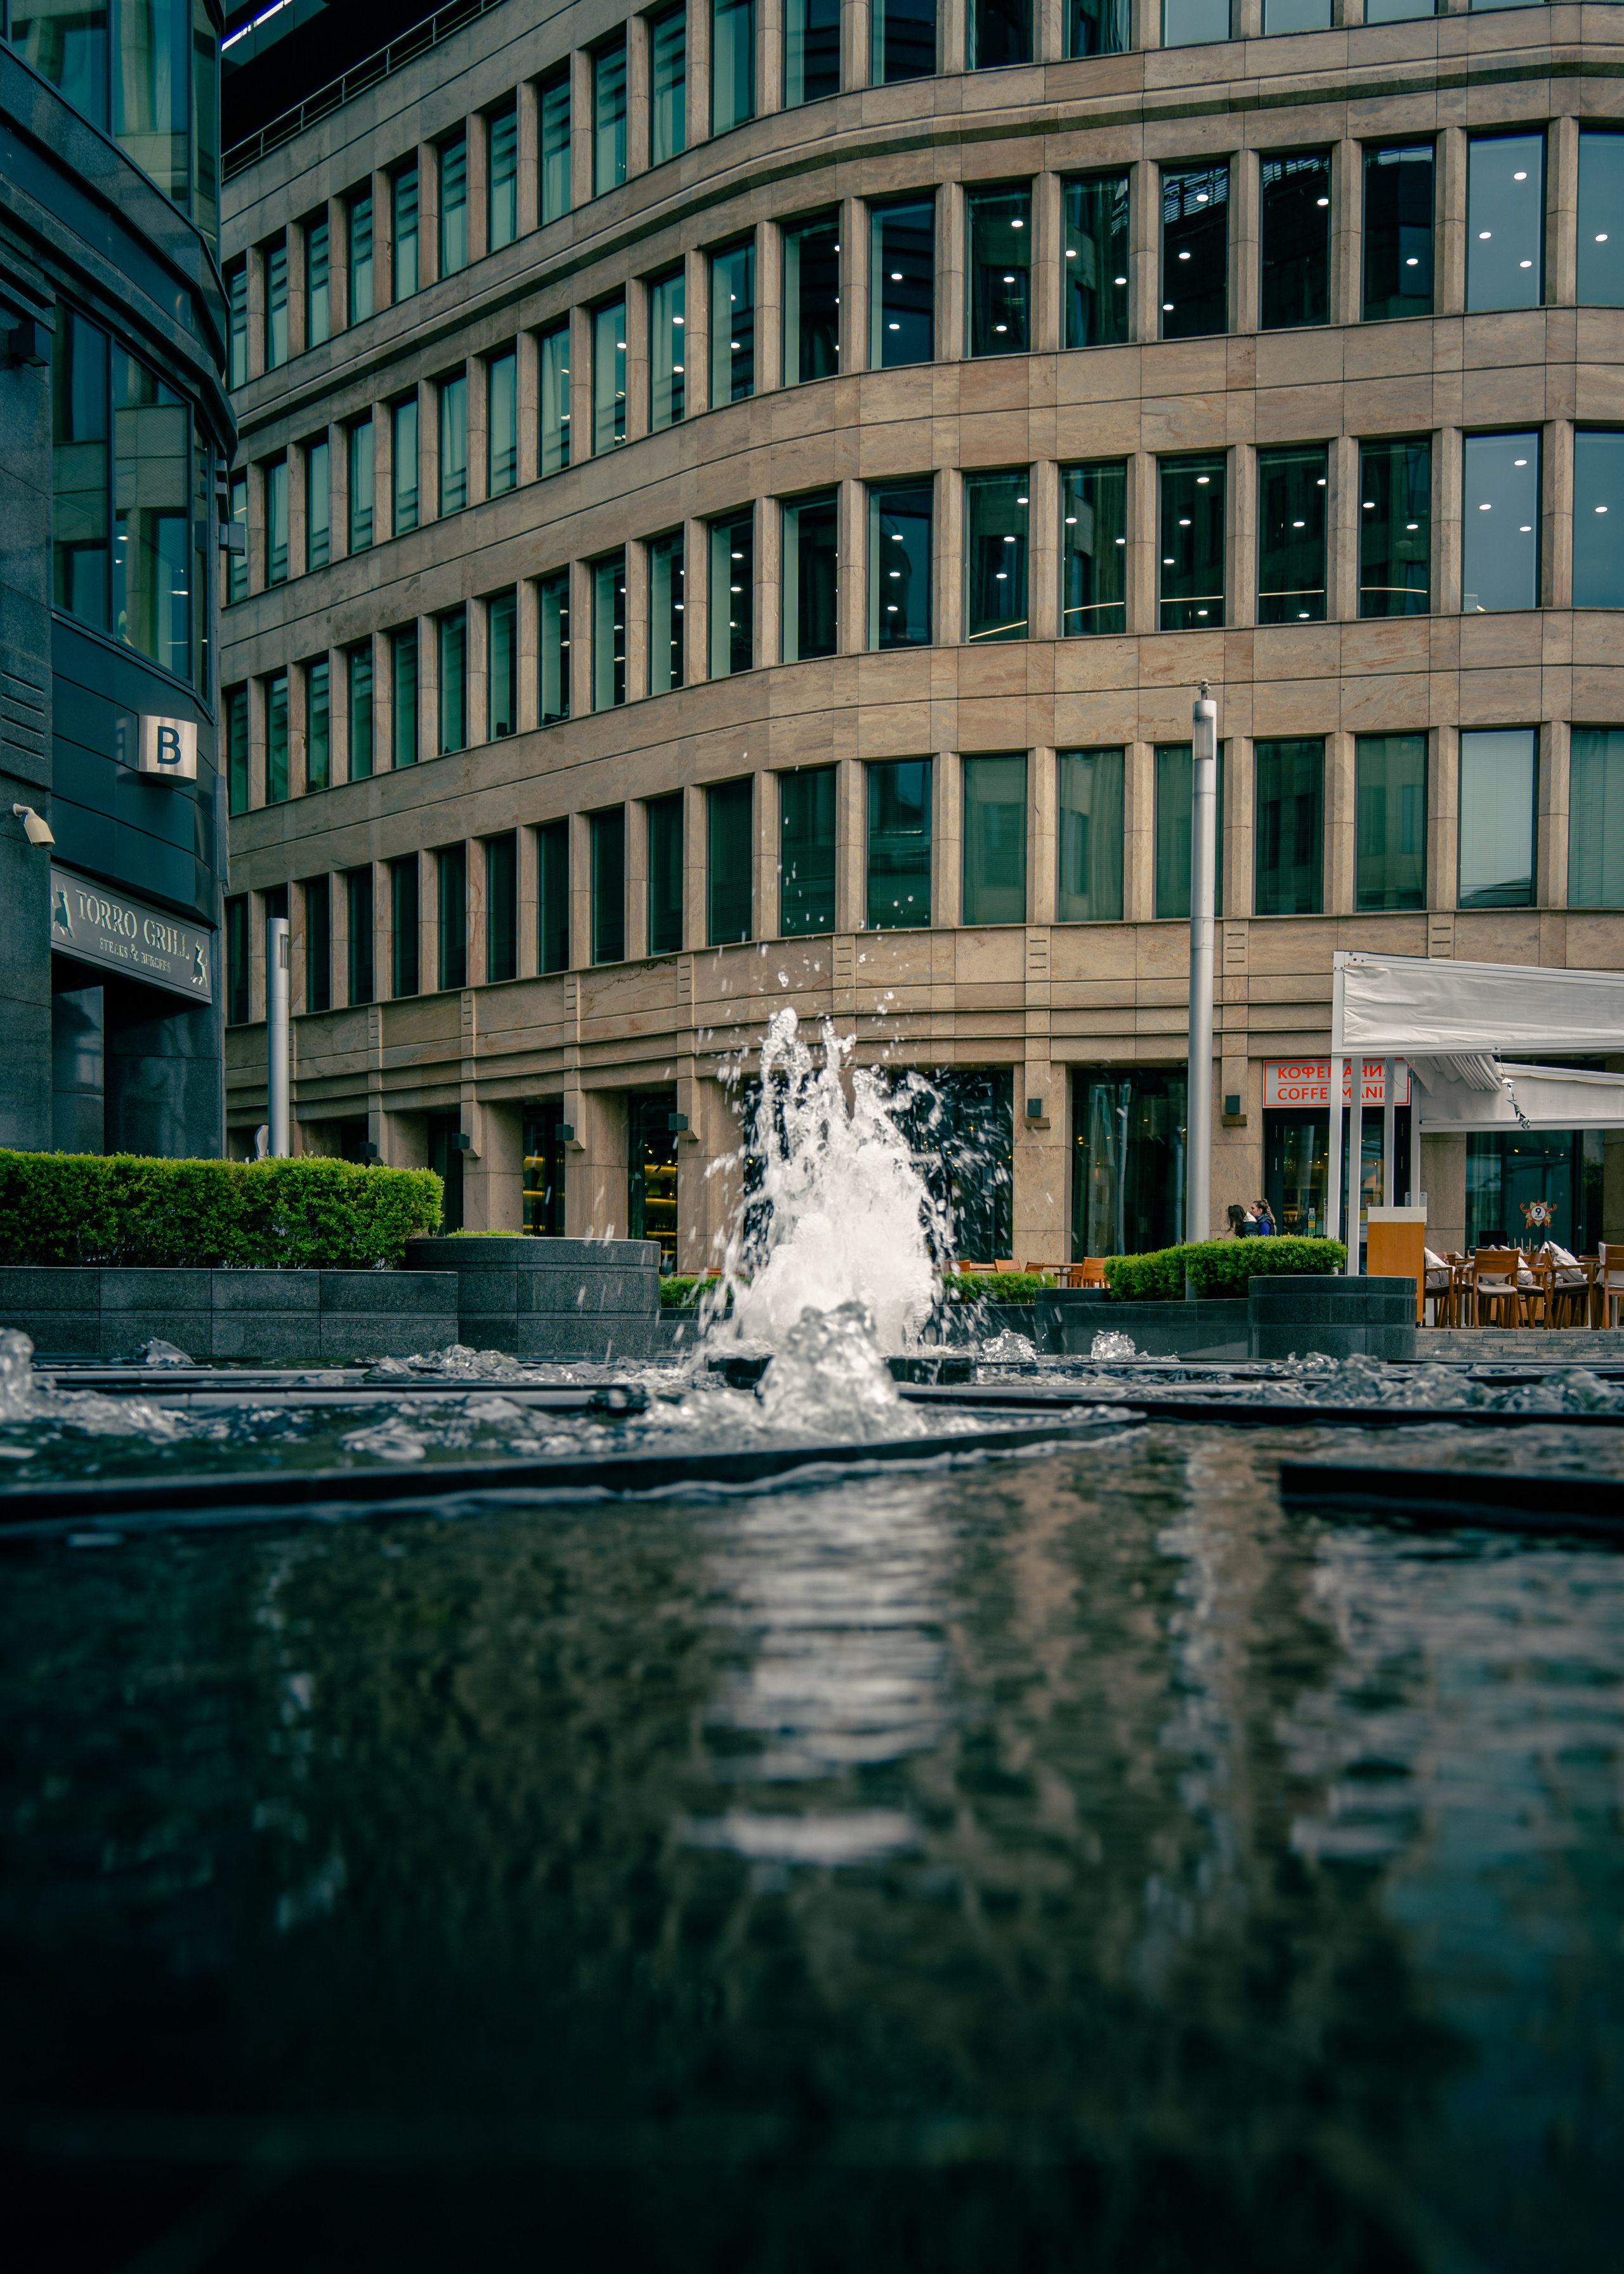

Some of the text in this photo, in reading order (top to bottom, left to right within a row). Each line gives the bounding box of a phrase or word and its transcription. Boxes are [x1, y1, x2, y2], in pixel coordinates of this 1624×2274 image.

[157, 725, 181, 765] B
[75, 889, 190, 960] TORRO GRILL
[99, 937, 172, 973] STEAKS & BURGERS
[1278, 1065, 1385, 1079] КОФЕАНИ
[1278, 1086, 1385, 1101] COFFEMNI
[1535, 1207, 1542, 1216] 9
